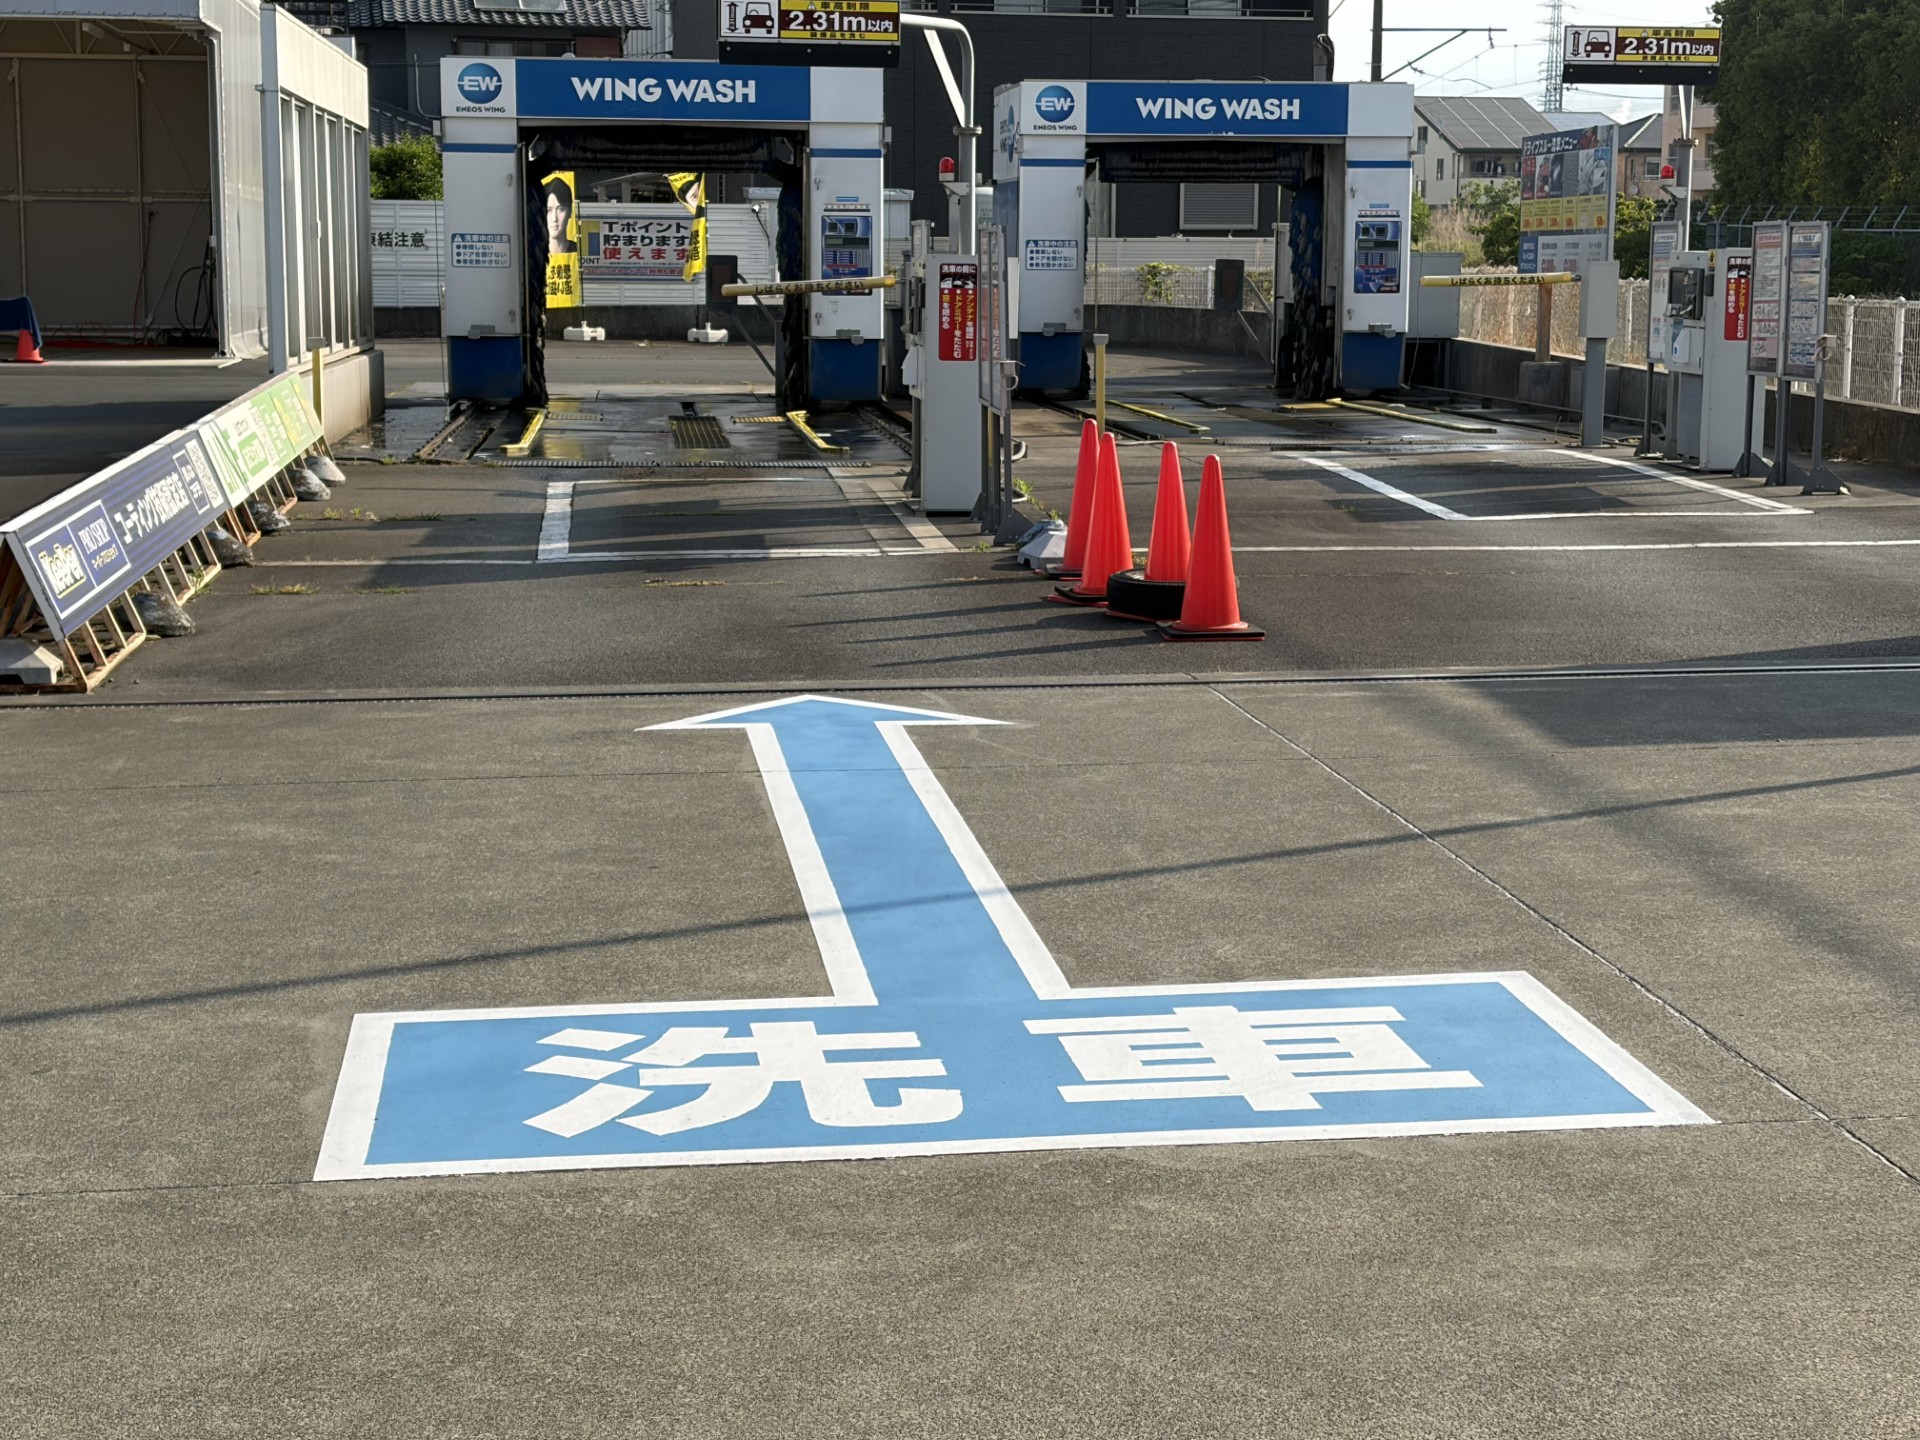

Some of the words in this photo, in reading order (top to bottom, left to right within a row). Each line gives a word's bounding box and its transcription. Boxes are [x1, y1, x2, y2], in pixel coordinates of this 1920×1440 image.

[820, 1, 870, 10] 車高制限
[788, 10, 893, 33] 2.31m以内
[1651, 29, 1695, 37] 車高制限
[1624, 38, 1714, 56] 2.31m以内
[463, 77, 498, 92] EW
[571, 77, 662, 105] WING
[666, 78, 757, 104] WASH
[455, 105, 483, 113] ENEOS
[484, 105, 506, 113] WING
[1040, 97, 1072, 111] EW
[1136, 97, 1216, 121] WING
[1220, 98, 1301, 121] WASH
[1522, 135, 1578, 157] ドライブスルー洗車メニュー
[602, 221, 689, 234] Tポイント
[464, 233, 509, 242] 洗車中の注意
[602, 234, 689, 247] 貯まります
[602, 247, 688, 261] 使えます
[1729, 257, 1751, 265] 洗車の前
[942, 264, 976, 274] 洗車の前に
[755, 280, 865, 295] しばらくお待ちください
[1450, 276, 1545, 286] しばらくお待ちください
[1736, 283, 1746, 338] ドアミラーをたたむ
[953, 295, 963, 359] ドアミラーをたたむ
[90, 517, 112, 547] SHOP
[524, 1005, 1485, 1138] 洗車
